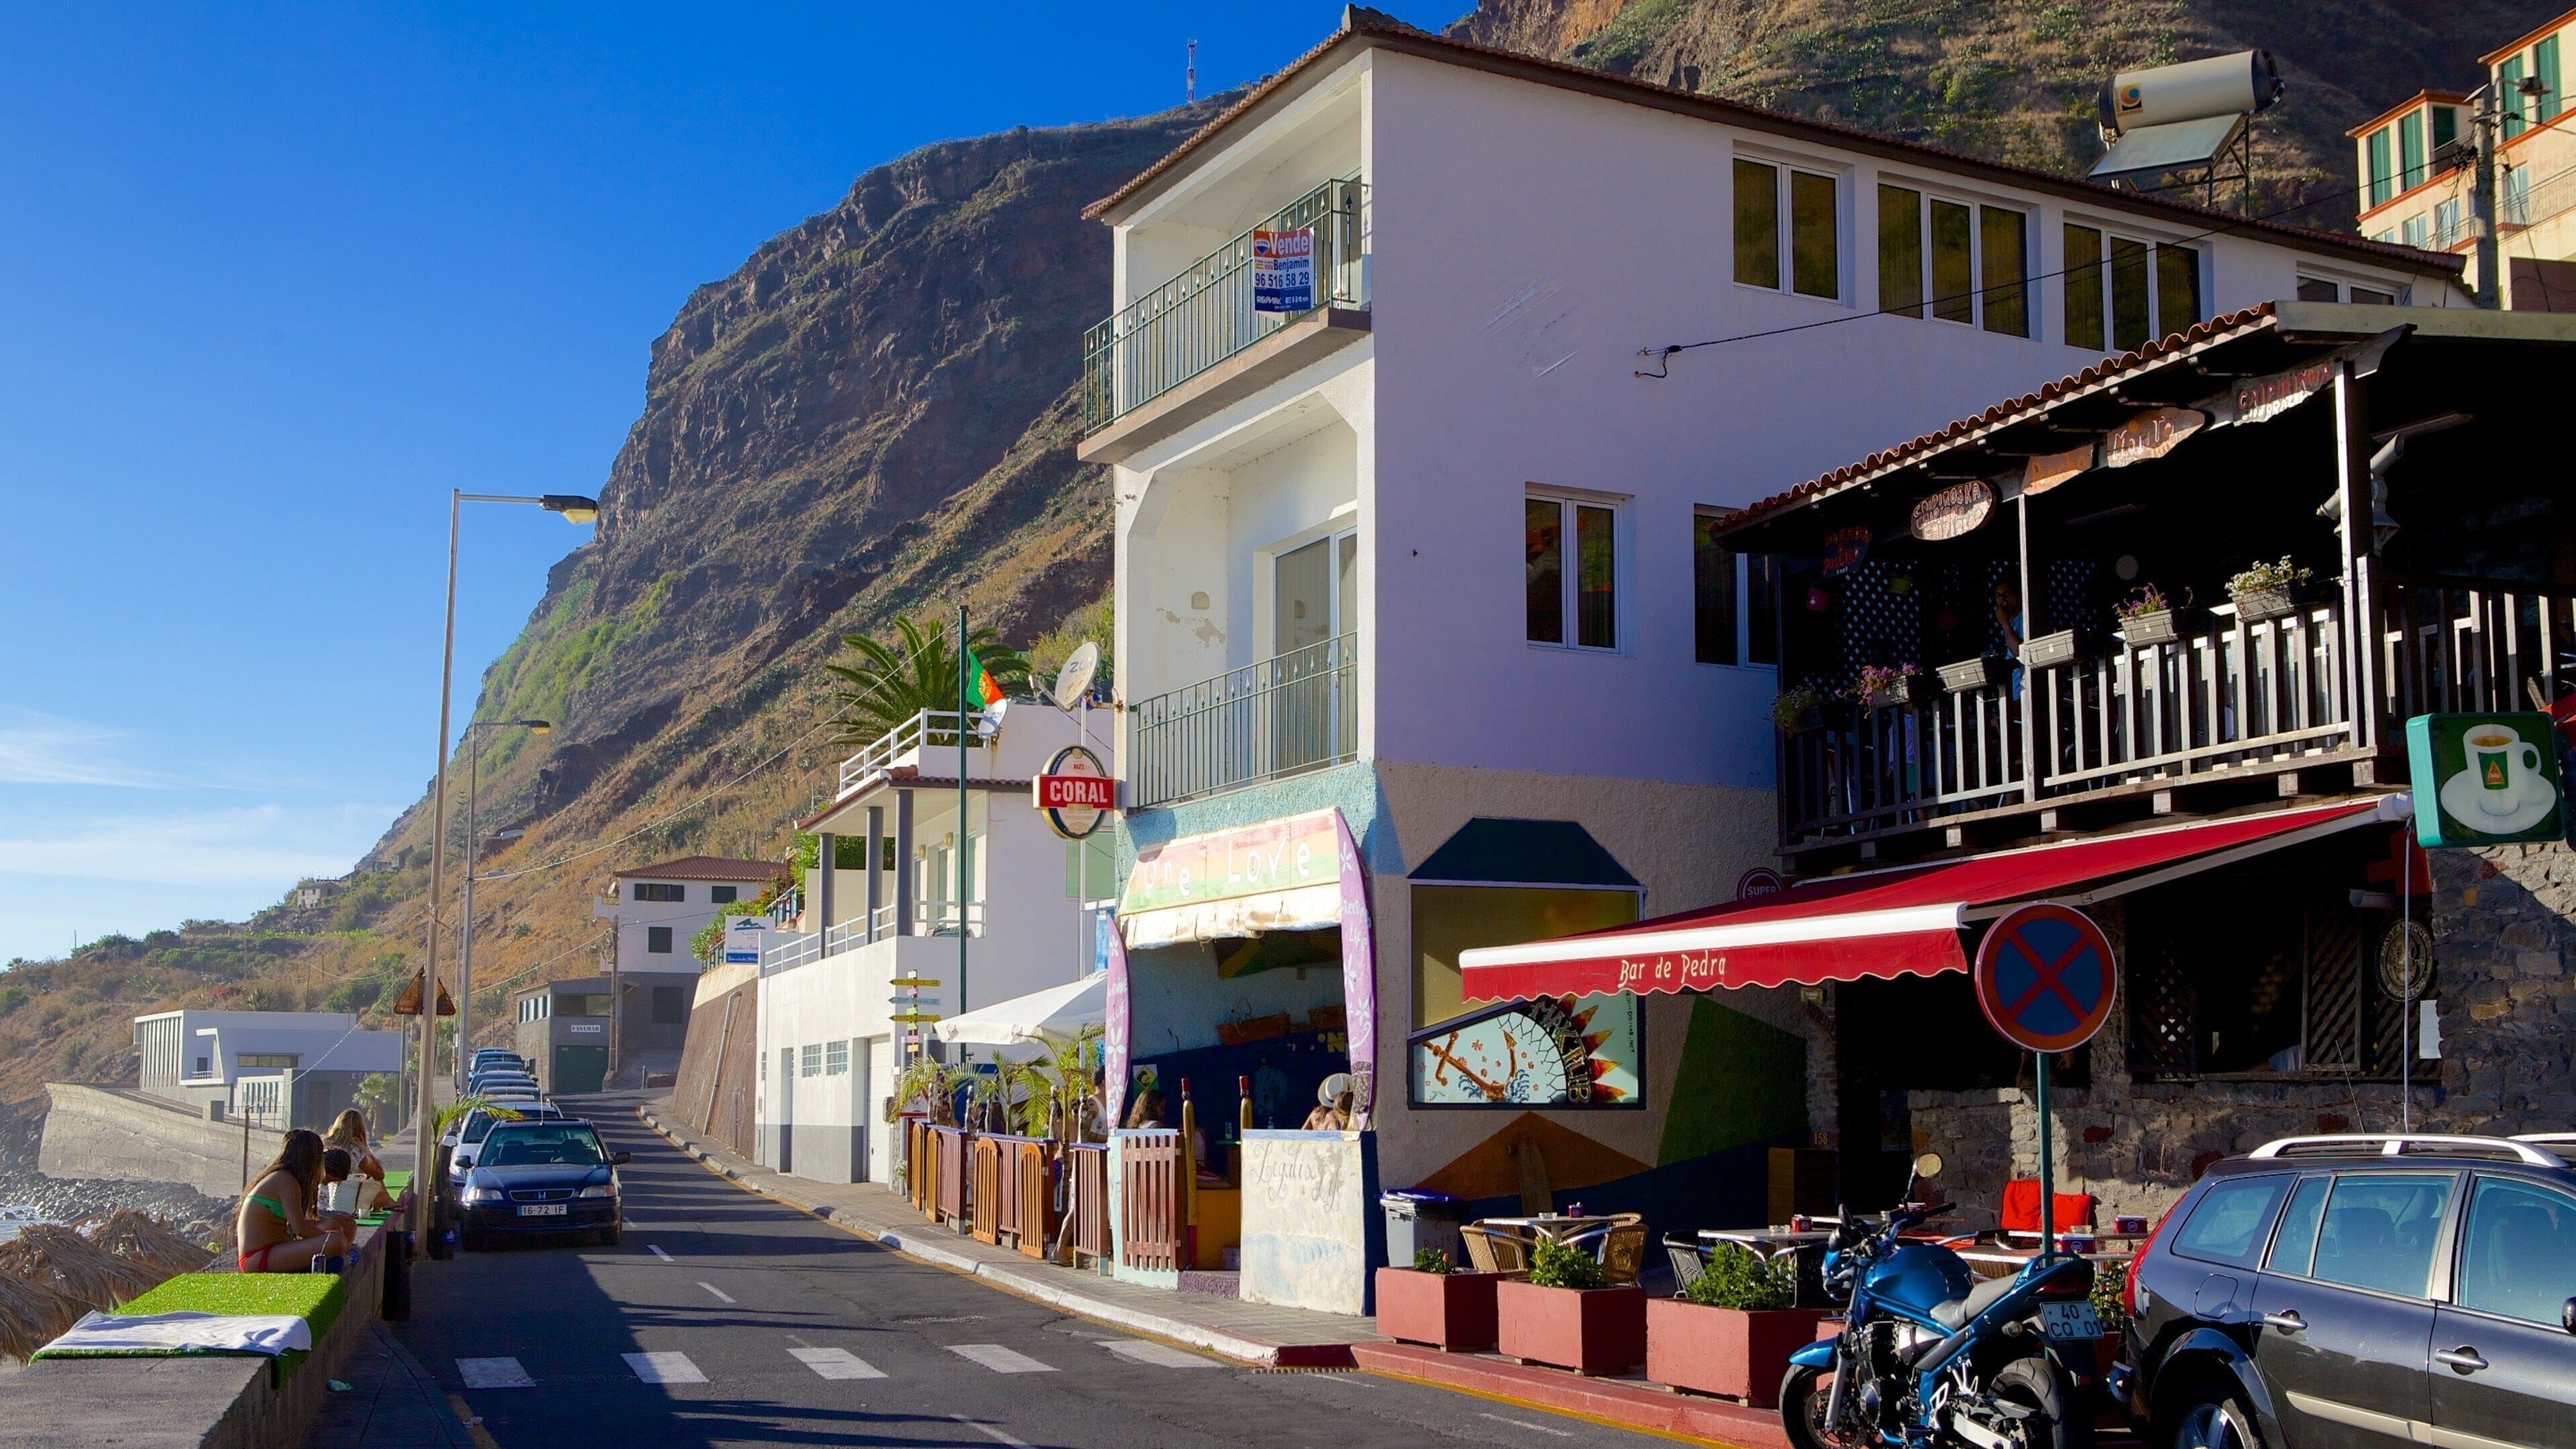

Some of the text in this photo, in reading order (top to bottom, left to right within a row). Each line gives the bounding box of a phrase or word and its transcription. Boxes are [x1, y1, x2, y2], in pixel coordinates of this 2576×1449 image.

[1269, 231, 1309, 255] Vende
[1273, 257, 1309, 272] Benjamim
[1255, 272, 1309, 288] 96 516 58 29
[1285, 295, 1309, 304] Elite
[1913, 482, 1981, 519] CAIPIROSKA
[1069, 658, 1094, 673] ZON
[1049, 780, 1108, 803] CORAL
[1142, 835, 1311, 897] One Love
[1617, 949, 1727, 989] Bar de Pedra
[1813, 1132, 1828, 1145] 158
[2061, 1304, 2080, 1320] 40
